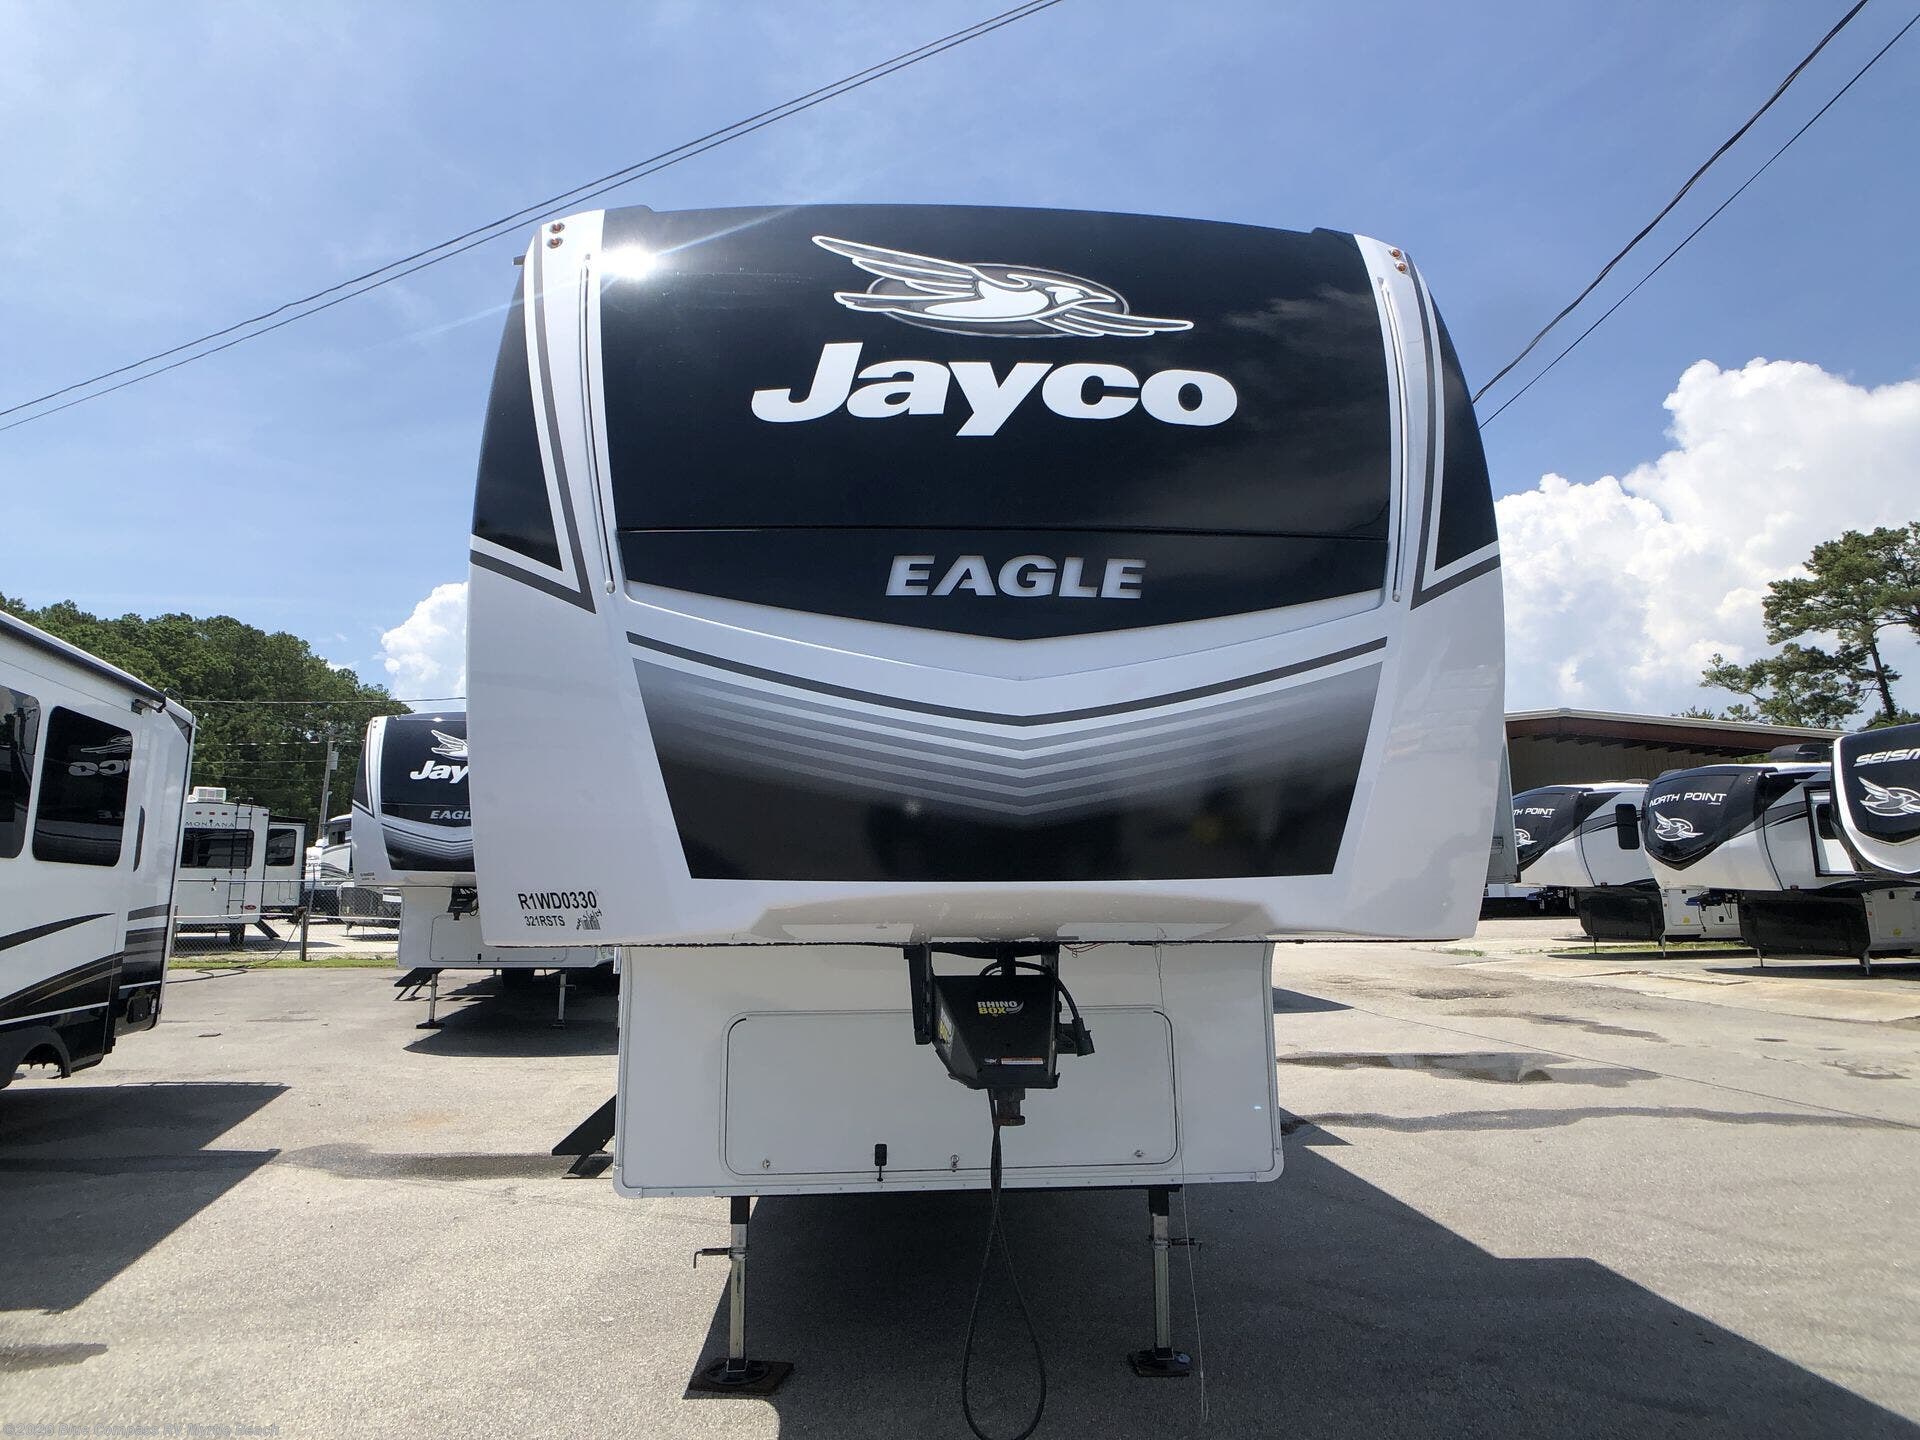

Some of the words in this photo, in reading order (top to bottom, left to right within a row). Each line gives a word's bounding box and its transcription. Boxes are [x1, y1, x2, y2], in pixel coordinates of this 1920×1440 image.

[751, 341, 1238, 437] Jayco
[885, 554, 1147, 600] EAGLE
[1648, 793, 1681, 808] NORTH
[1683, 792, 1727, 802] POINT
[1525, 807, 1556, 816] POINT
[184, 821, 236, 829] MONTANA
[517, 890, 598, 910] R1WD0330
[524, 915, 566, 927] 321RSTS
[977, 1000, 1018, 1008] RHINO
